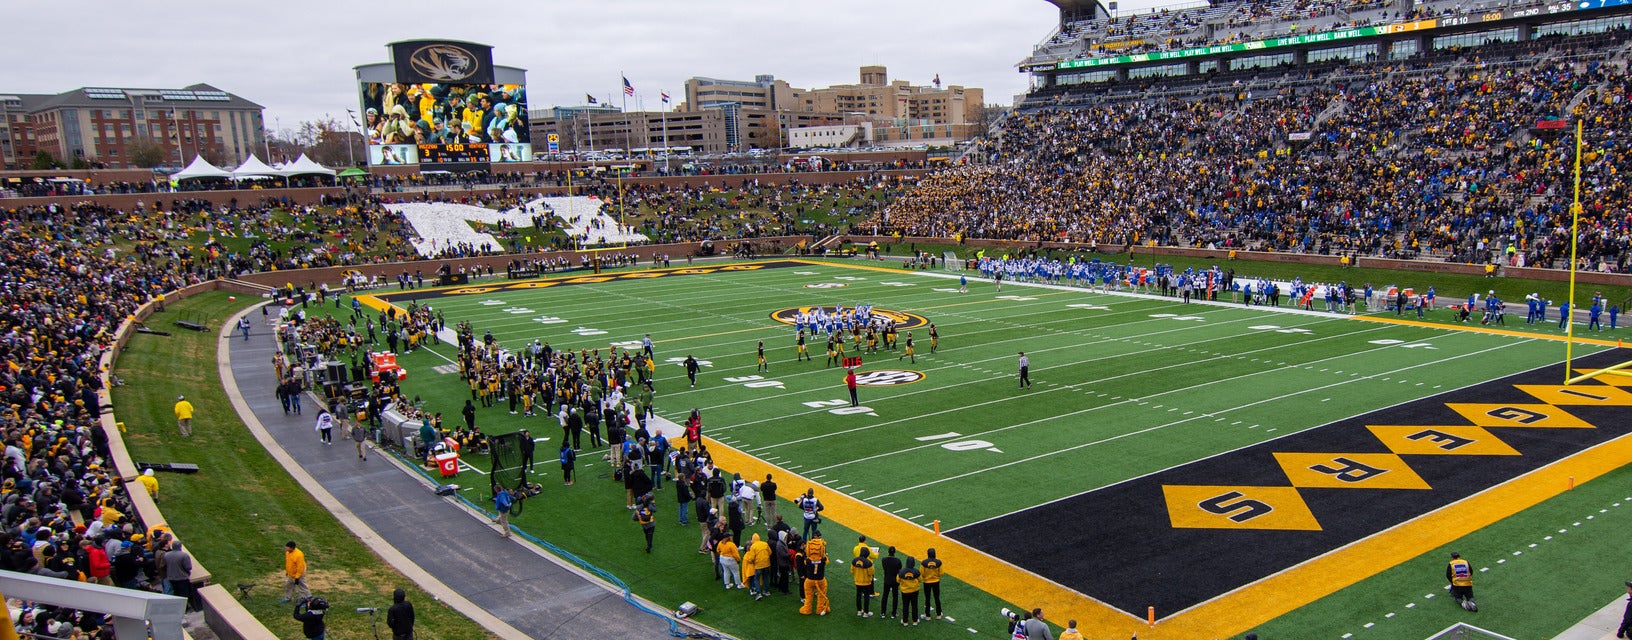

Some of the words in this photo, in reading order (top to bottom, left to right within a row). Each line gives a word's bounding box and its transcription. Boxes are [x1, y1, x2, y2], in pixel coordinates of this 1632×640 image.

[1525, 8, 1540, 16] 2ND
[1561, 3, 1572, 12] 35
[1441, 18, 1452, 27] 1ST
[1458, 16, 1468, 24] 10
[1481, 13, 1501, 22] 15:00
[1333, 31, 1347, 39] BANK
[424, 149, 430, 157] 3
[802, 398, 874, 416] 20
[915, 431, 994, 452] 10
[444, 460, 454, 471] G
